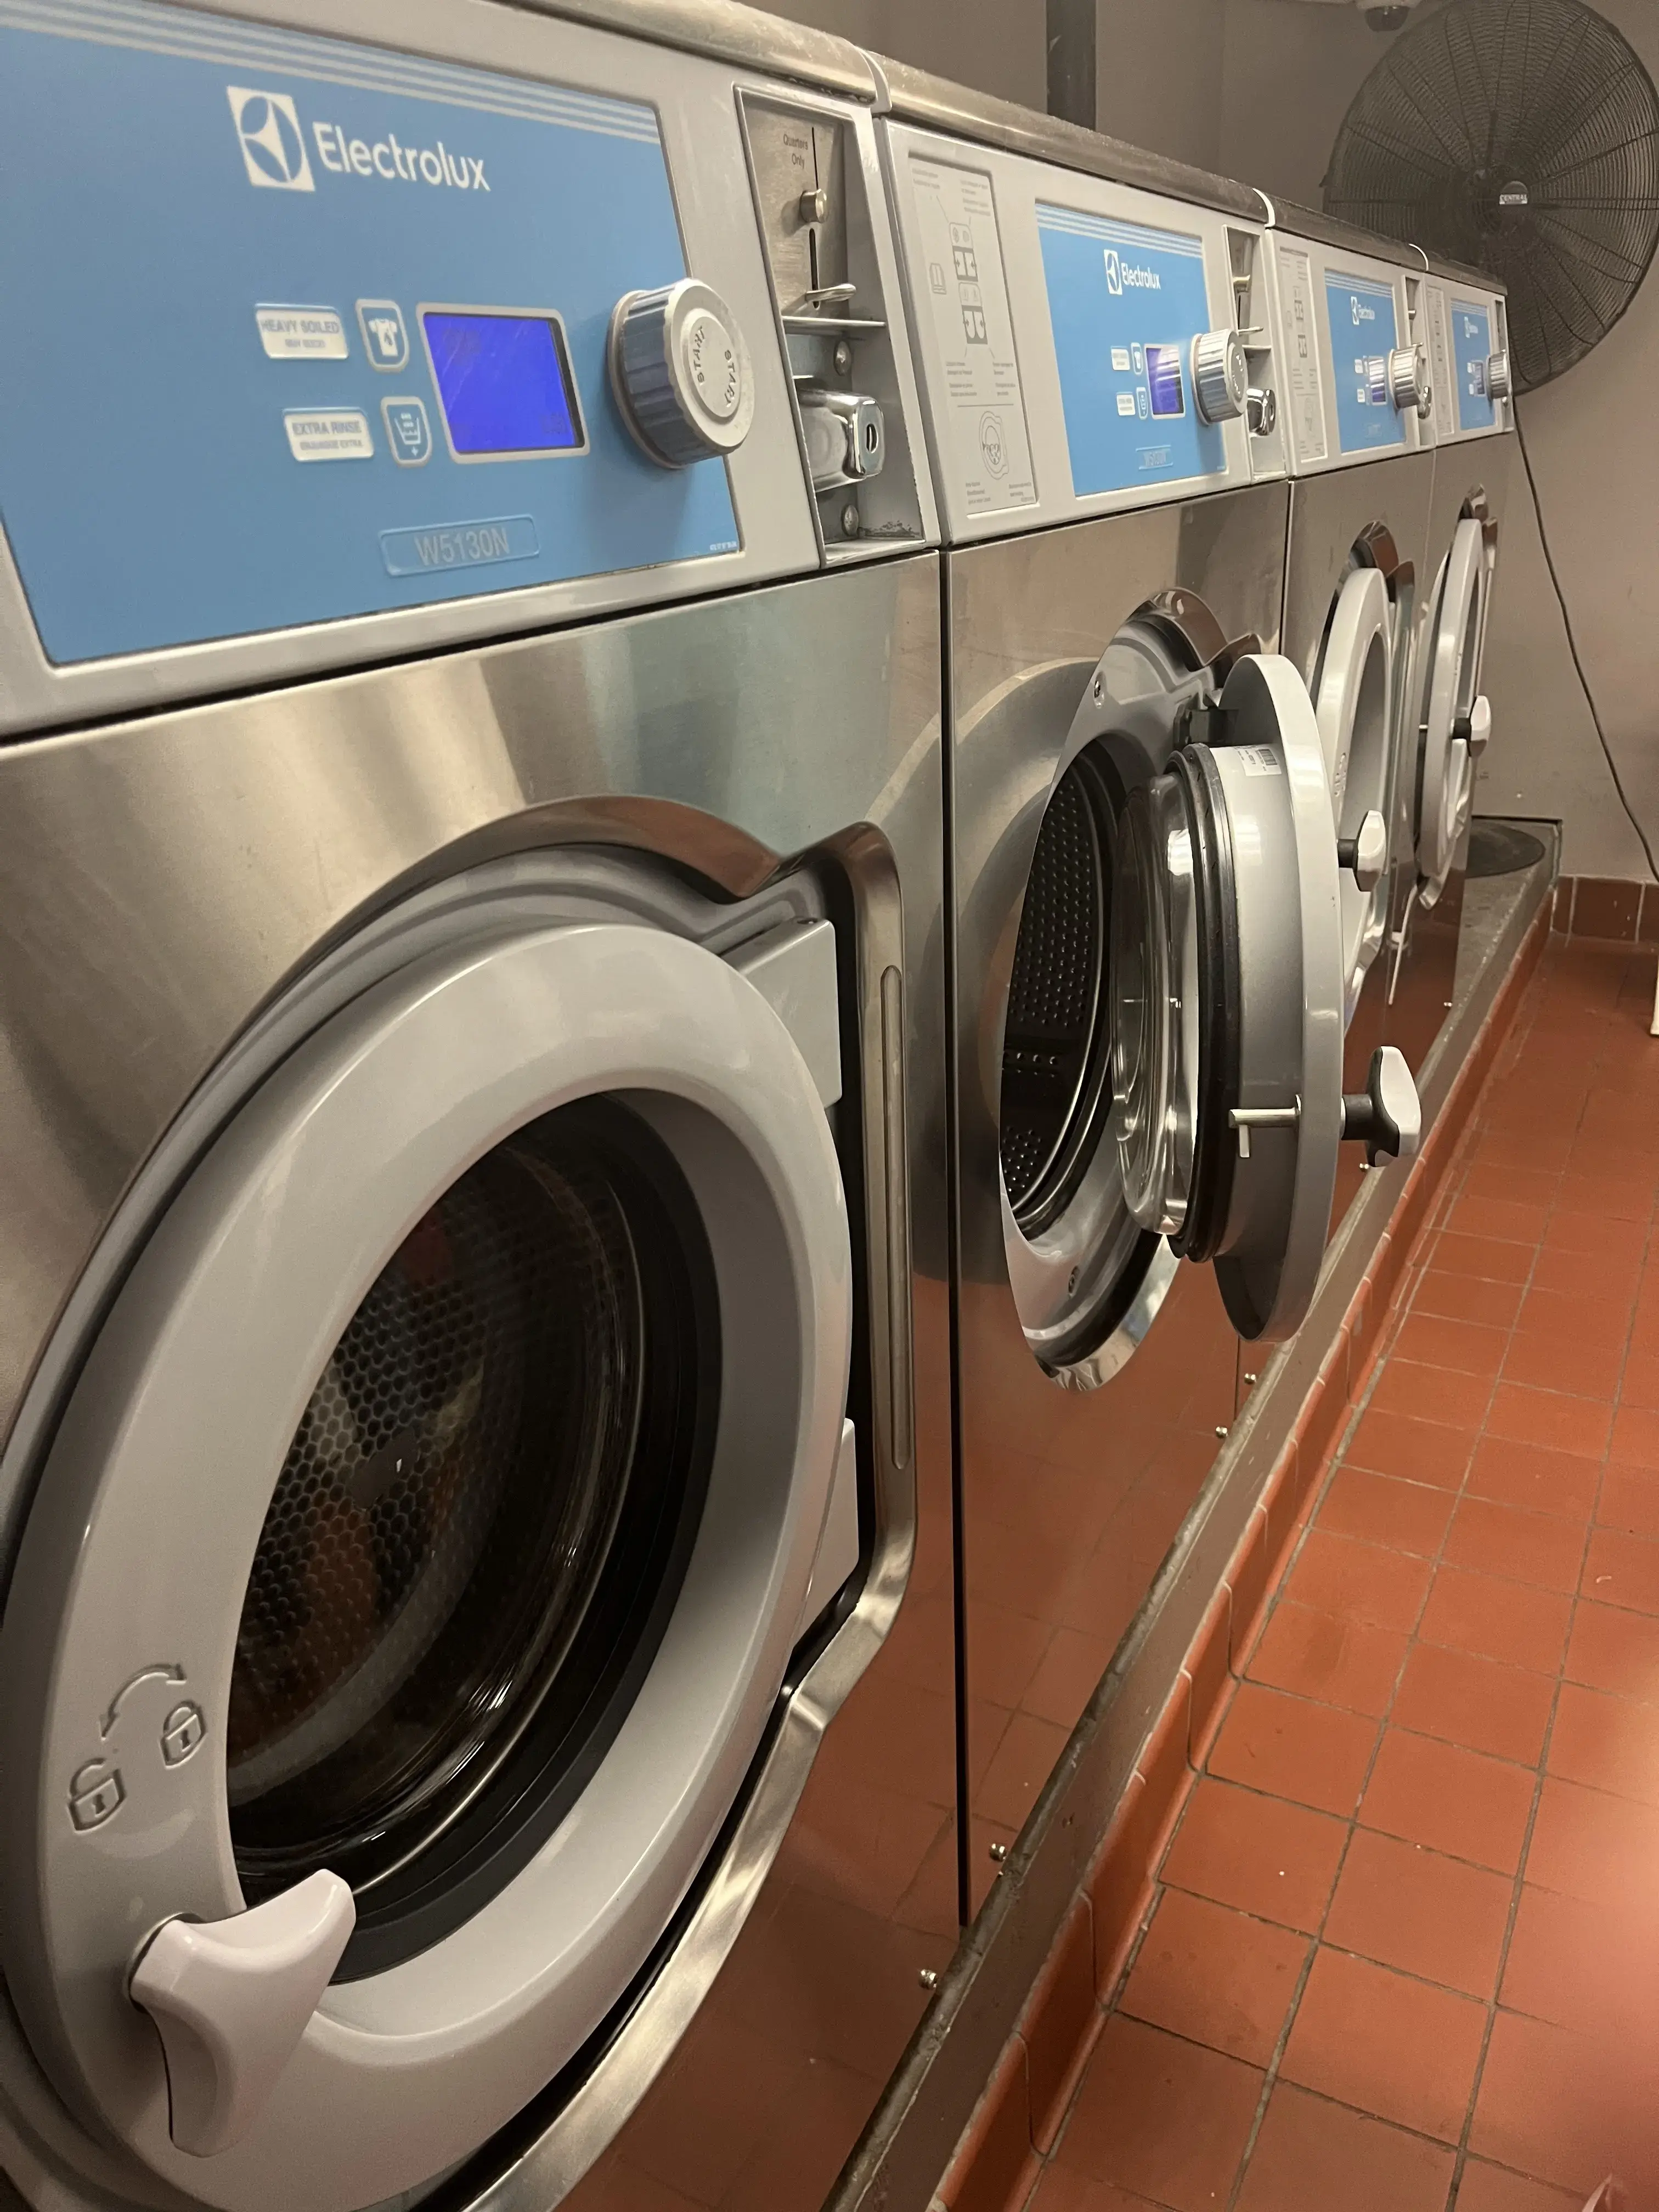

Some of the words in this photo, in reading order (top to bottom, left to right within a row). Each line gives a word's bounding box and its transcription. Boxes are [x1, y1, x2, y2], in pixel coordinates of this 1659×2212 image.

[313, 121, 491, 192] Electrolux
[792, 153, 805, 170] Only
[1121, 262, 1161, 290] Electrolux
[260, 319, 297, 332] HEAVY
[301, 320, 340, 334] SOILED
[693, 325, 705, 383] START
[724, 349, 736, 404] START
[292, 422, 329, 436] EXTRA
[330, 421, 362, 434] RINSE
[414, 527, 510, 566] W5130N
